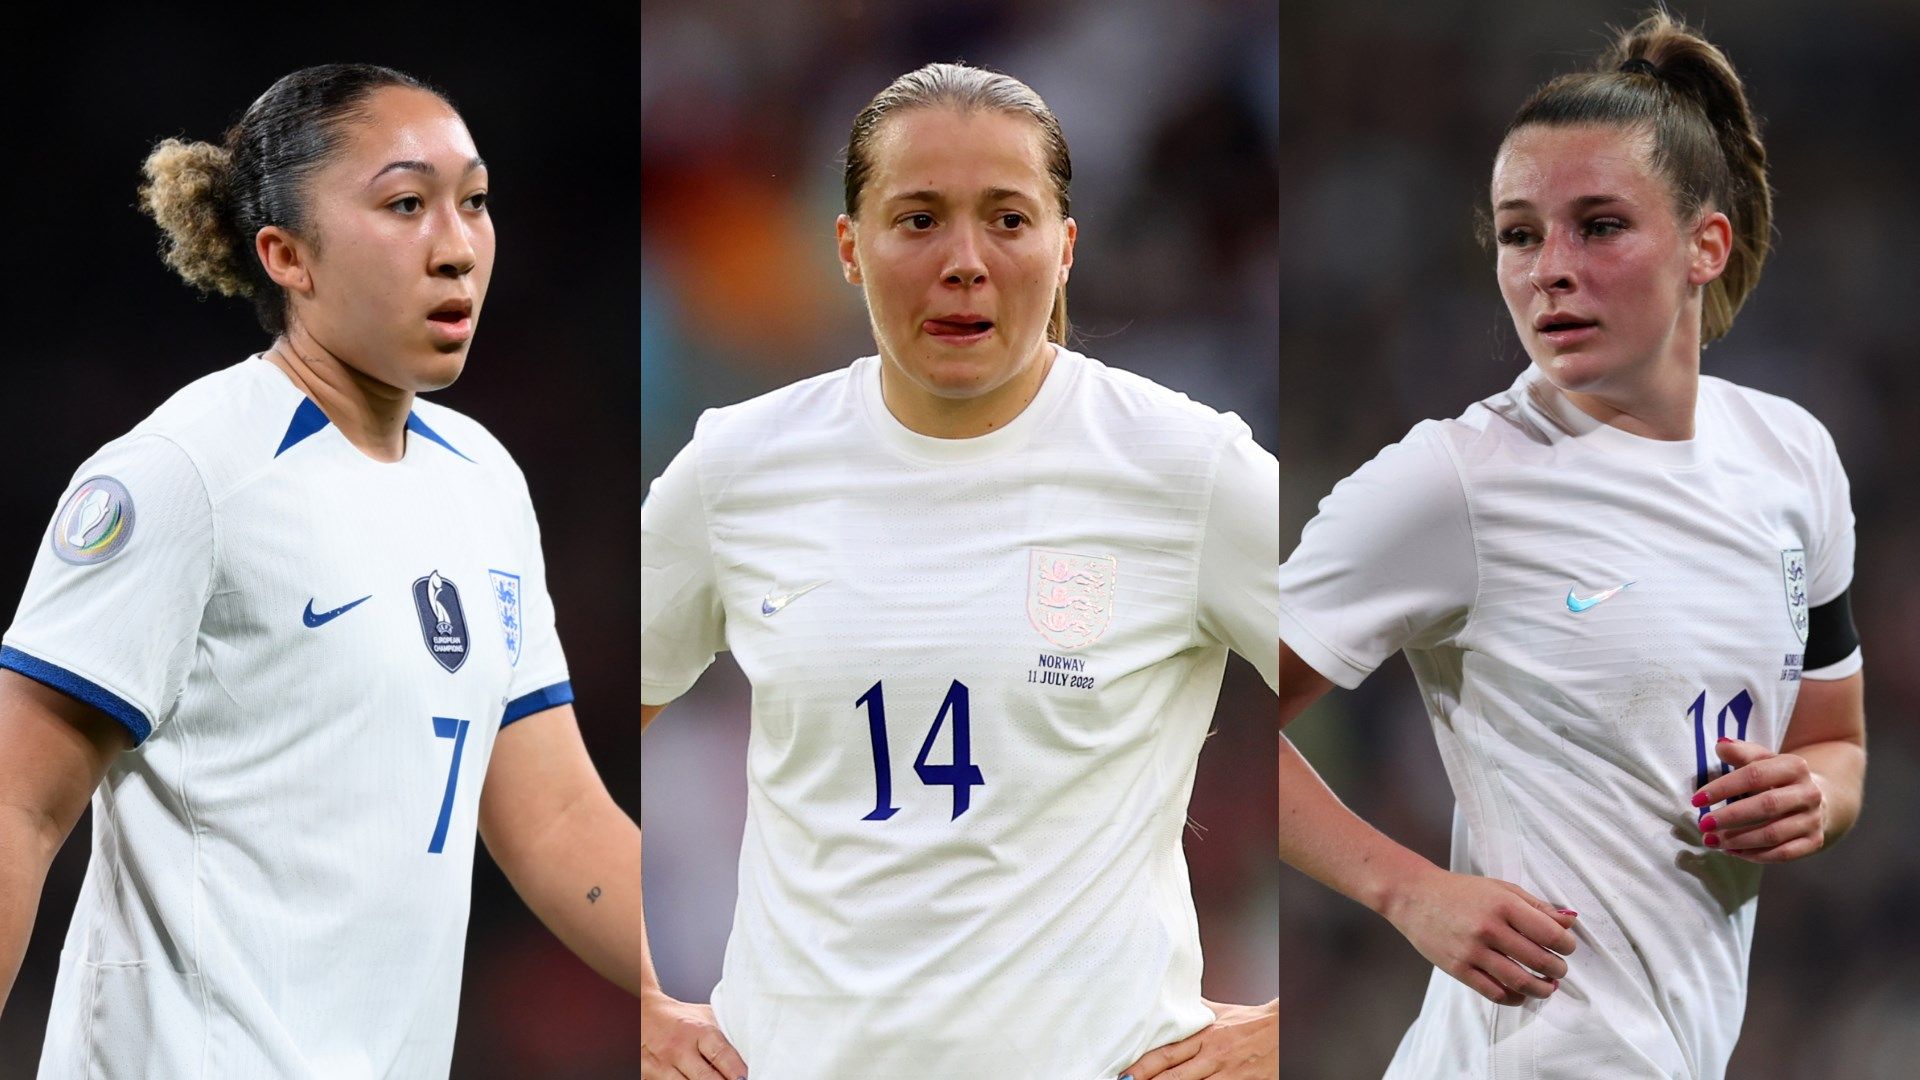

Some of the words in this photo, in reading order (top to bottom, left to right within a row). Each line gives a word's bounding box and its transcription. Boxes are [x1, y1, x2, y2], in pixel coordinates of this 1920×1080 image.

[433, 636, 461, 644] EUROPEAN
[433, 644, 464, 653] CHAMPIONS
[1038, 653, 1086, 672] NORWAY
[1027, 669, 1037, 683] 11
[1039, 670, 1069, 686] JULY
[1070, 675, 1094, 689] 2022
[856, 679, 985, 821] 14
[427, 716, 470, 855] 7
